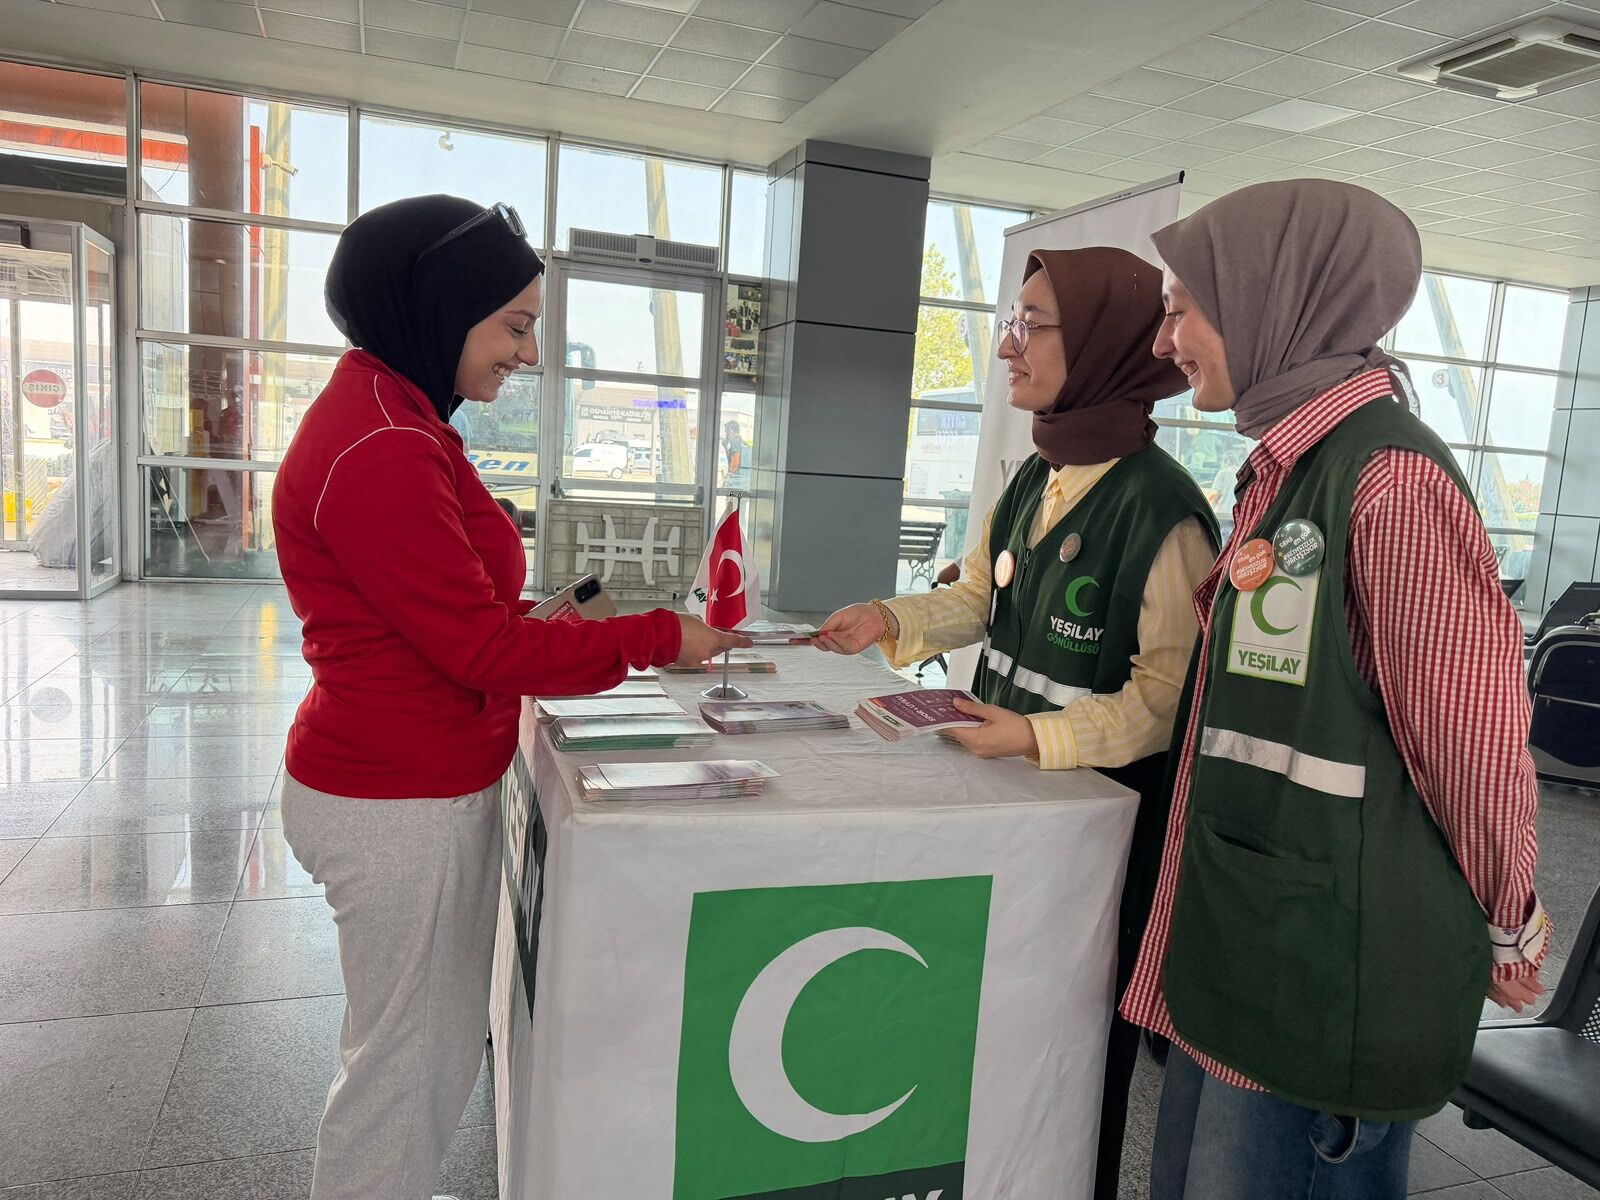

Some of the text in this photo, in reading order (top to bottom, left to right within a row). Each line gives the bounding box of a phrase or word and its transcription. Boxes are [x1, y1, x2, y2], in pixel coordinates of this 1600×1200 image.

[1050, 615, 1105, 641] YEŞİLAY
[1046, 632, 1100, 655] GÖNÜLLÜSÜ
[1238, 649, 1302, 675] YEŞİLAY
